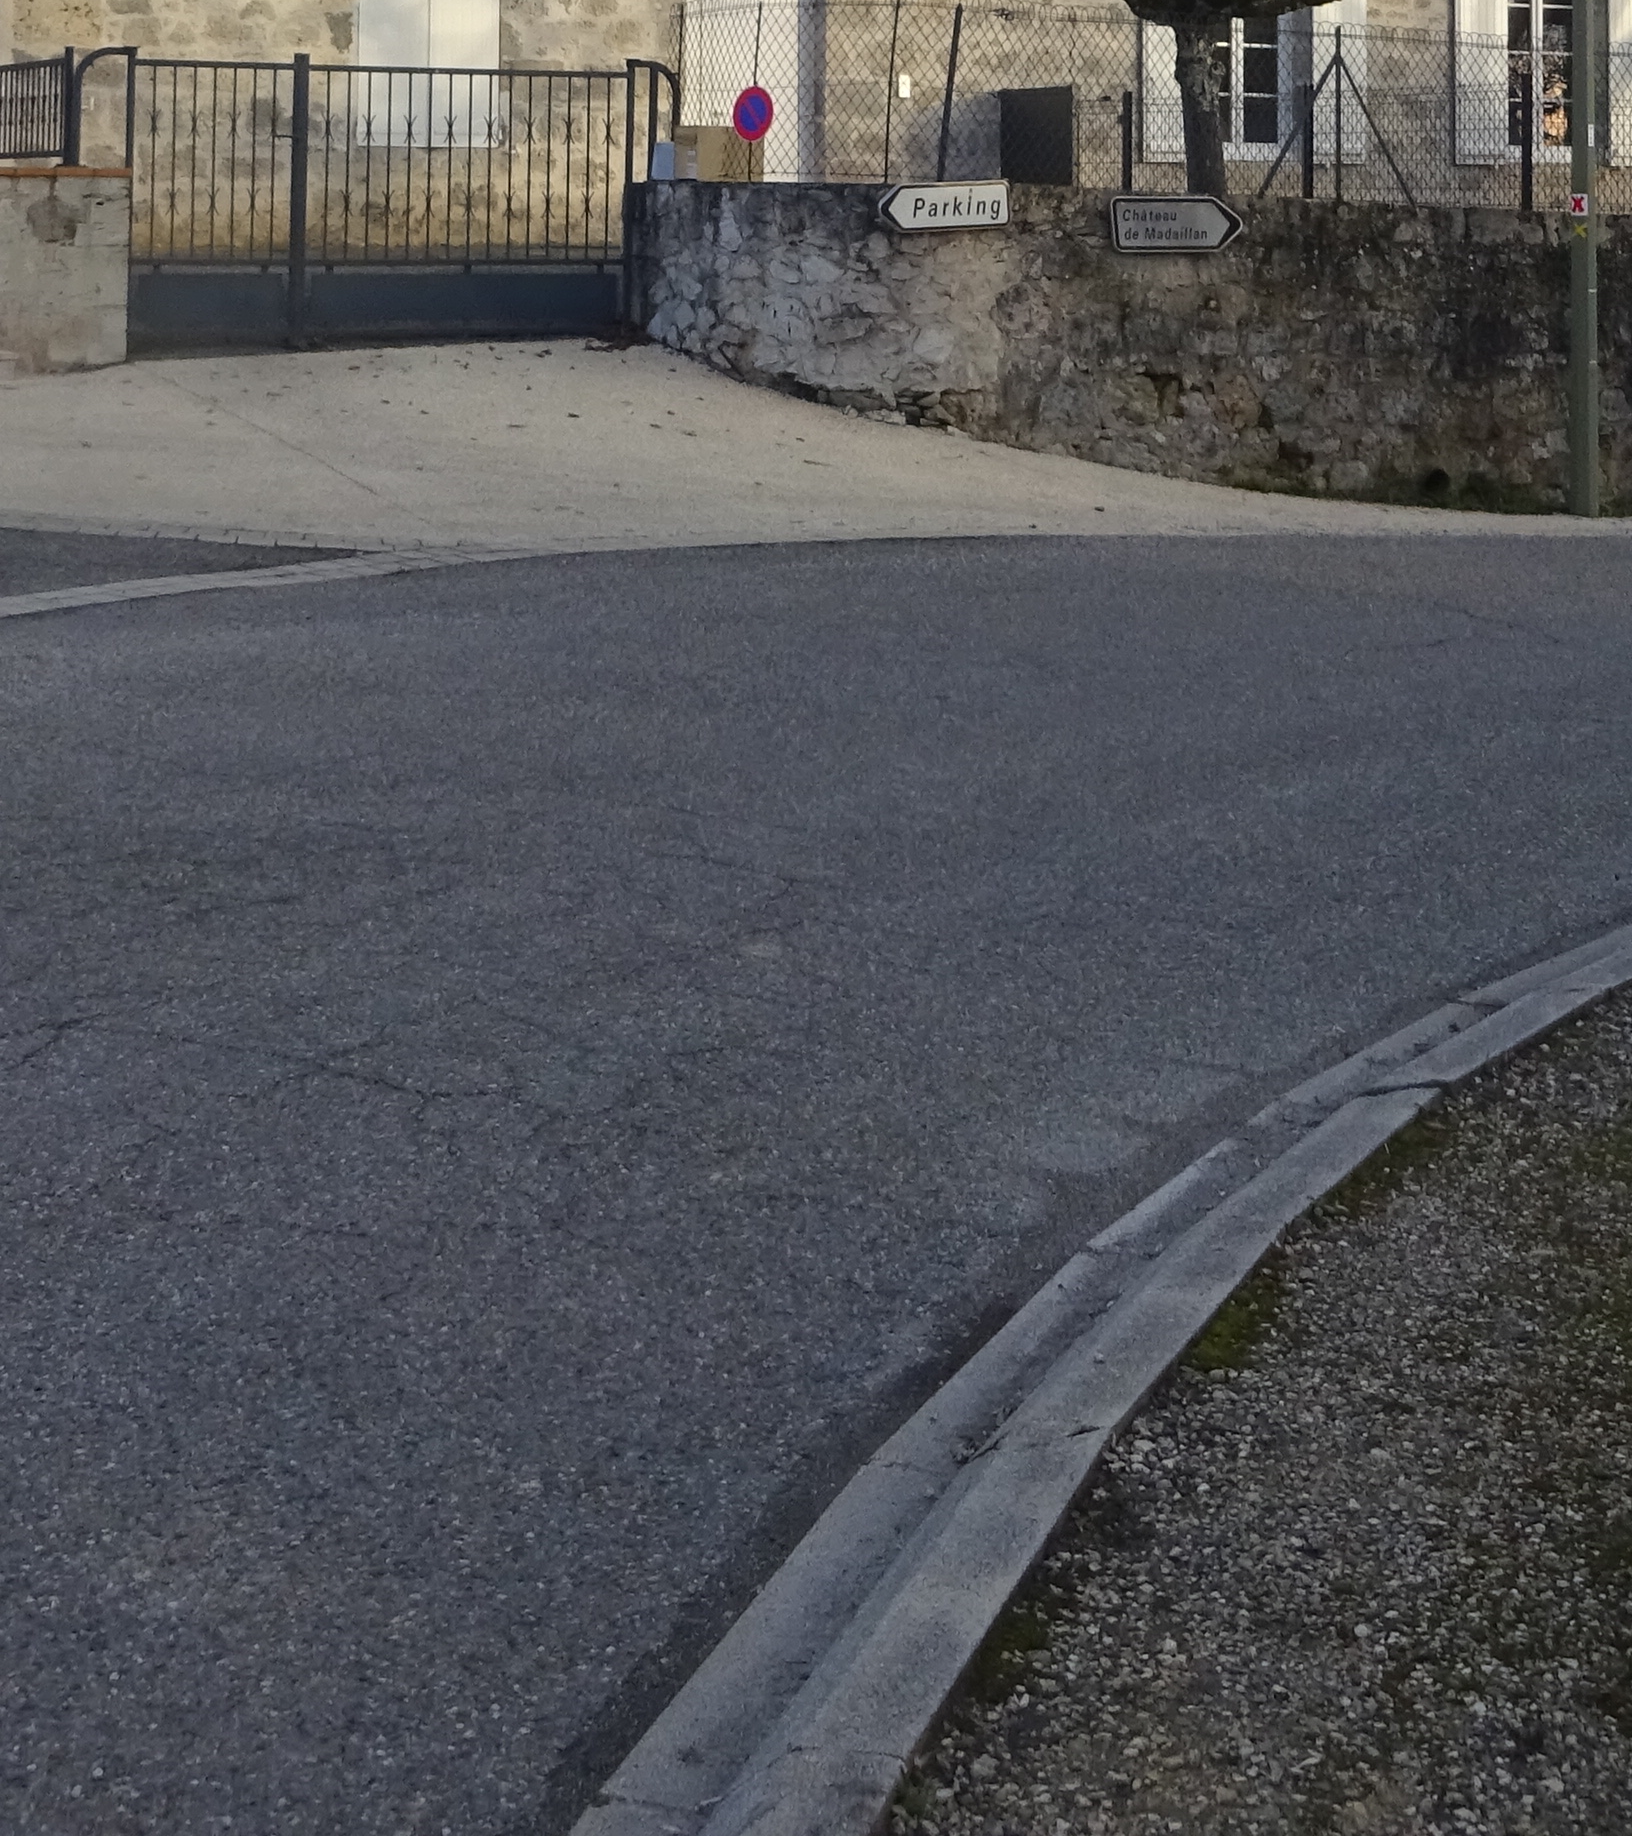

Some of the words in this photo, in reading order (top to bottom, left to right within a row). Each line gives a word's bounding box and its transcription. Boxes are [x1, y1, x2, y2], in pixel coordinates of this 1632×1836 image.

[913, 188, 1001, 220] Parking
[1122, 209, 1177, 222] Château
[1124, 228, 1139, 240] de
[1144, 227, 1208, 240] Madaillan
